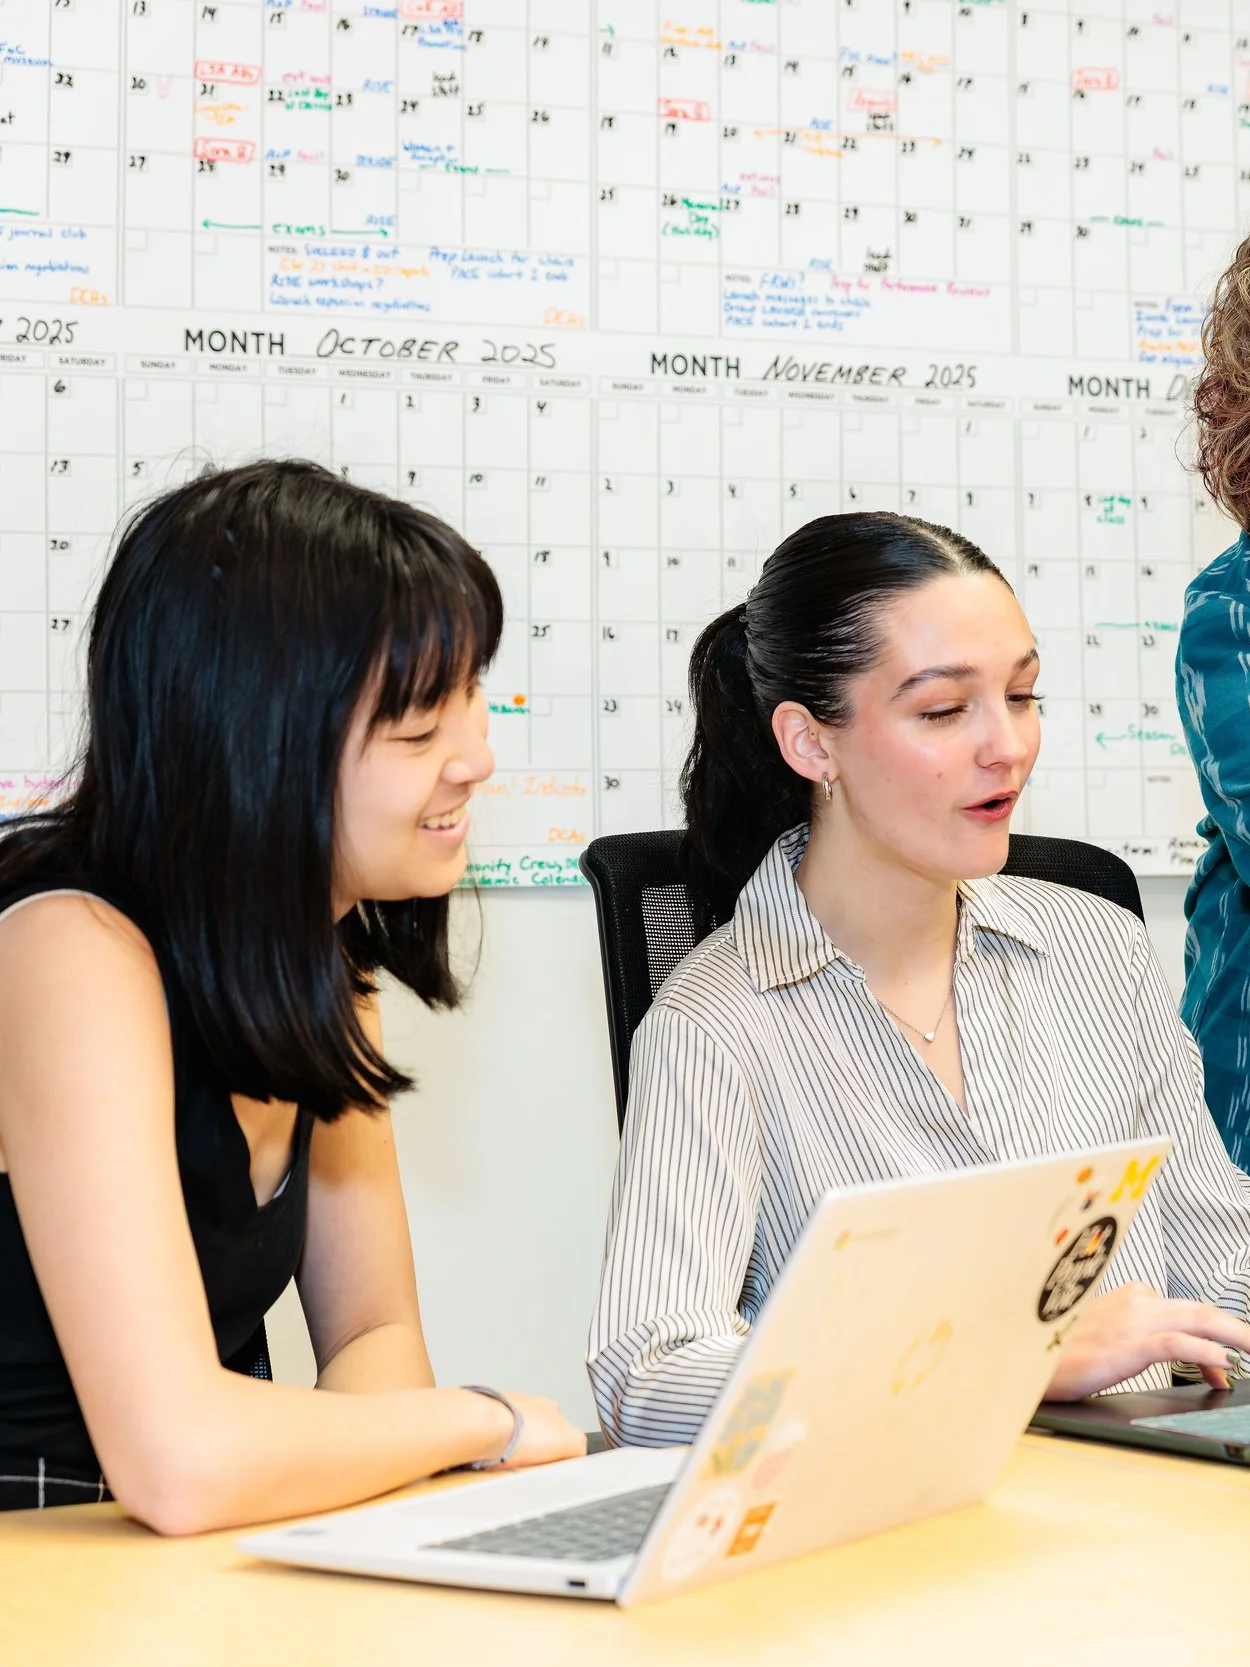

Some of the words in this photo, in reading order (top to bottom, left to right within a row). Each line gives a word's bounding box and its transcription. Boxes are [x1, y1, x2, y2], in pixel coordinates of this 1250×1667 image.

[133, 0, 147, 16] 13
[201, 5, 217, 20] 14
[400, 100, 419, 113] 24
[466, 103, 485, 117] 25
[531, 110, 550, 123] 26
[54, 151, 72, 164] 29
[128, 155, 146, 169] 27
[599, 187, 615, 201] 25
[15, 316, 79, 345] 2025
[184, 328, 285, 356] MONTH
[316, 328, 460, 363] OCTOBER
[479, 339, 557, 369] 2025
[58, 355, 106, 367] SATURDAY
[139, 359, 176, 370] SUNDAY
[208, 362, 247, 373] MONDAY
[277, 366, 317, 376] TUESDAY
[338, 368, 391, 379] WEDNESDAY
[410, 371, 453, 382] THURSDAY
[481, 375, 511, 385] FRIDAY
[539, 378, 582, 389] SATURDAY
[650, 352, 740, 379] MONTH
[762, 355, 907, 388] NOVEMBER
[923, 363, 978, 389] 2025
[53, 379, 67, 394] 6
[1067, 374, 1151, 400] MONTH
[339, 392, 347, 405] 1
[406, 395, 415, 409] 2
[611, 382, 644, 391] SUNDAY
[671, 385, 707, 394] MONDAY
[734, 387, 769, 397] TUESDAY
[787, 391, 835, 401] WEDNESDAY
[851, 393, 890, 403] THURSDAY
[914, 397, 941, 406] FRIDAY
[967, 400, 1005, 409] SATURDAY
[472, 396, 481, 413] 3
[536, 401, 547, 414] 4
[965, 421, 973, 434] 1
[50, 459, 70, 474] 13
[132, 460, 145, 477] 5
[407, 470, 417, 487] 9
[469, 473, 484, 484] 10
[534, 475, 547, 487] 11
[604, 477, 613, 491] 2
[667, 480, 675, 495] 3
[728, 483, 737, 499] 4
[789, 483, 798, 498] 5
[50, 618, 72, 631] 27
[531, 624, 551, 638] 25
[602, 626, 616, 640] 16
[666, 628, 679, 643] 17
[603, 699, 619, 713] 23
[665, 700, 683, 716] 24
[1143, 702, 1160, 718] 30
[604, 775, 621, 791] 30
[1108, 1155, 1162, 1204] M
